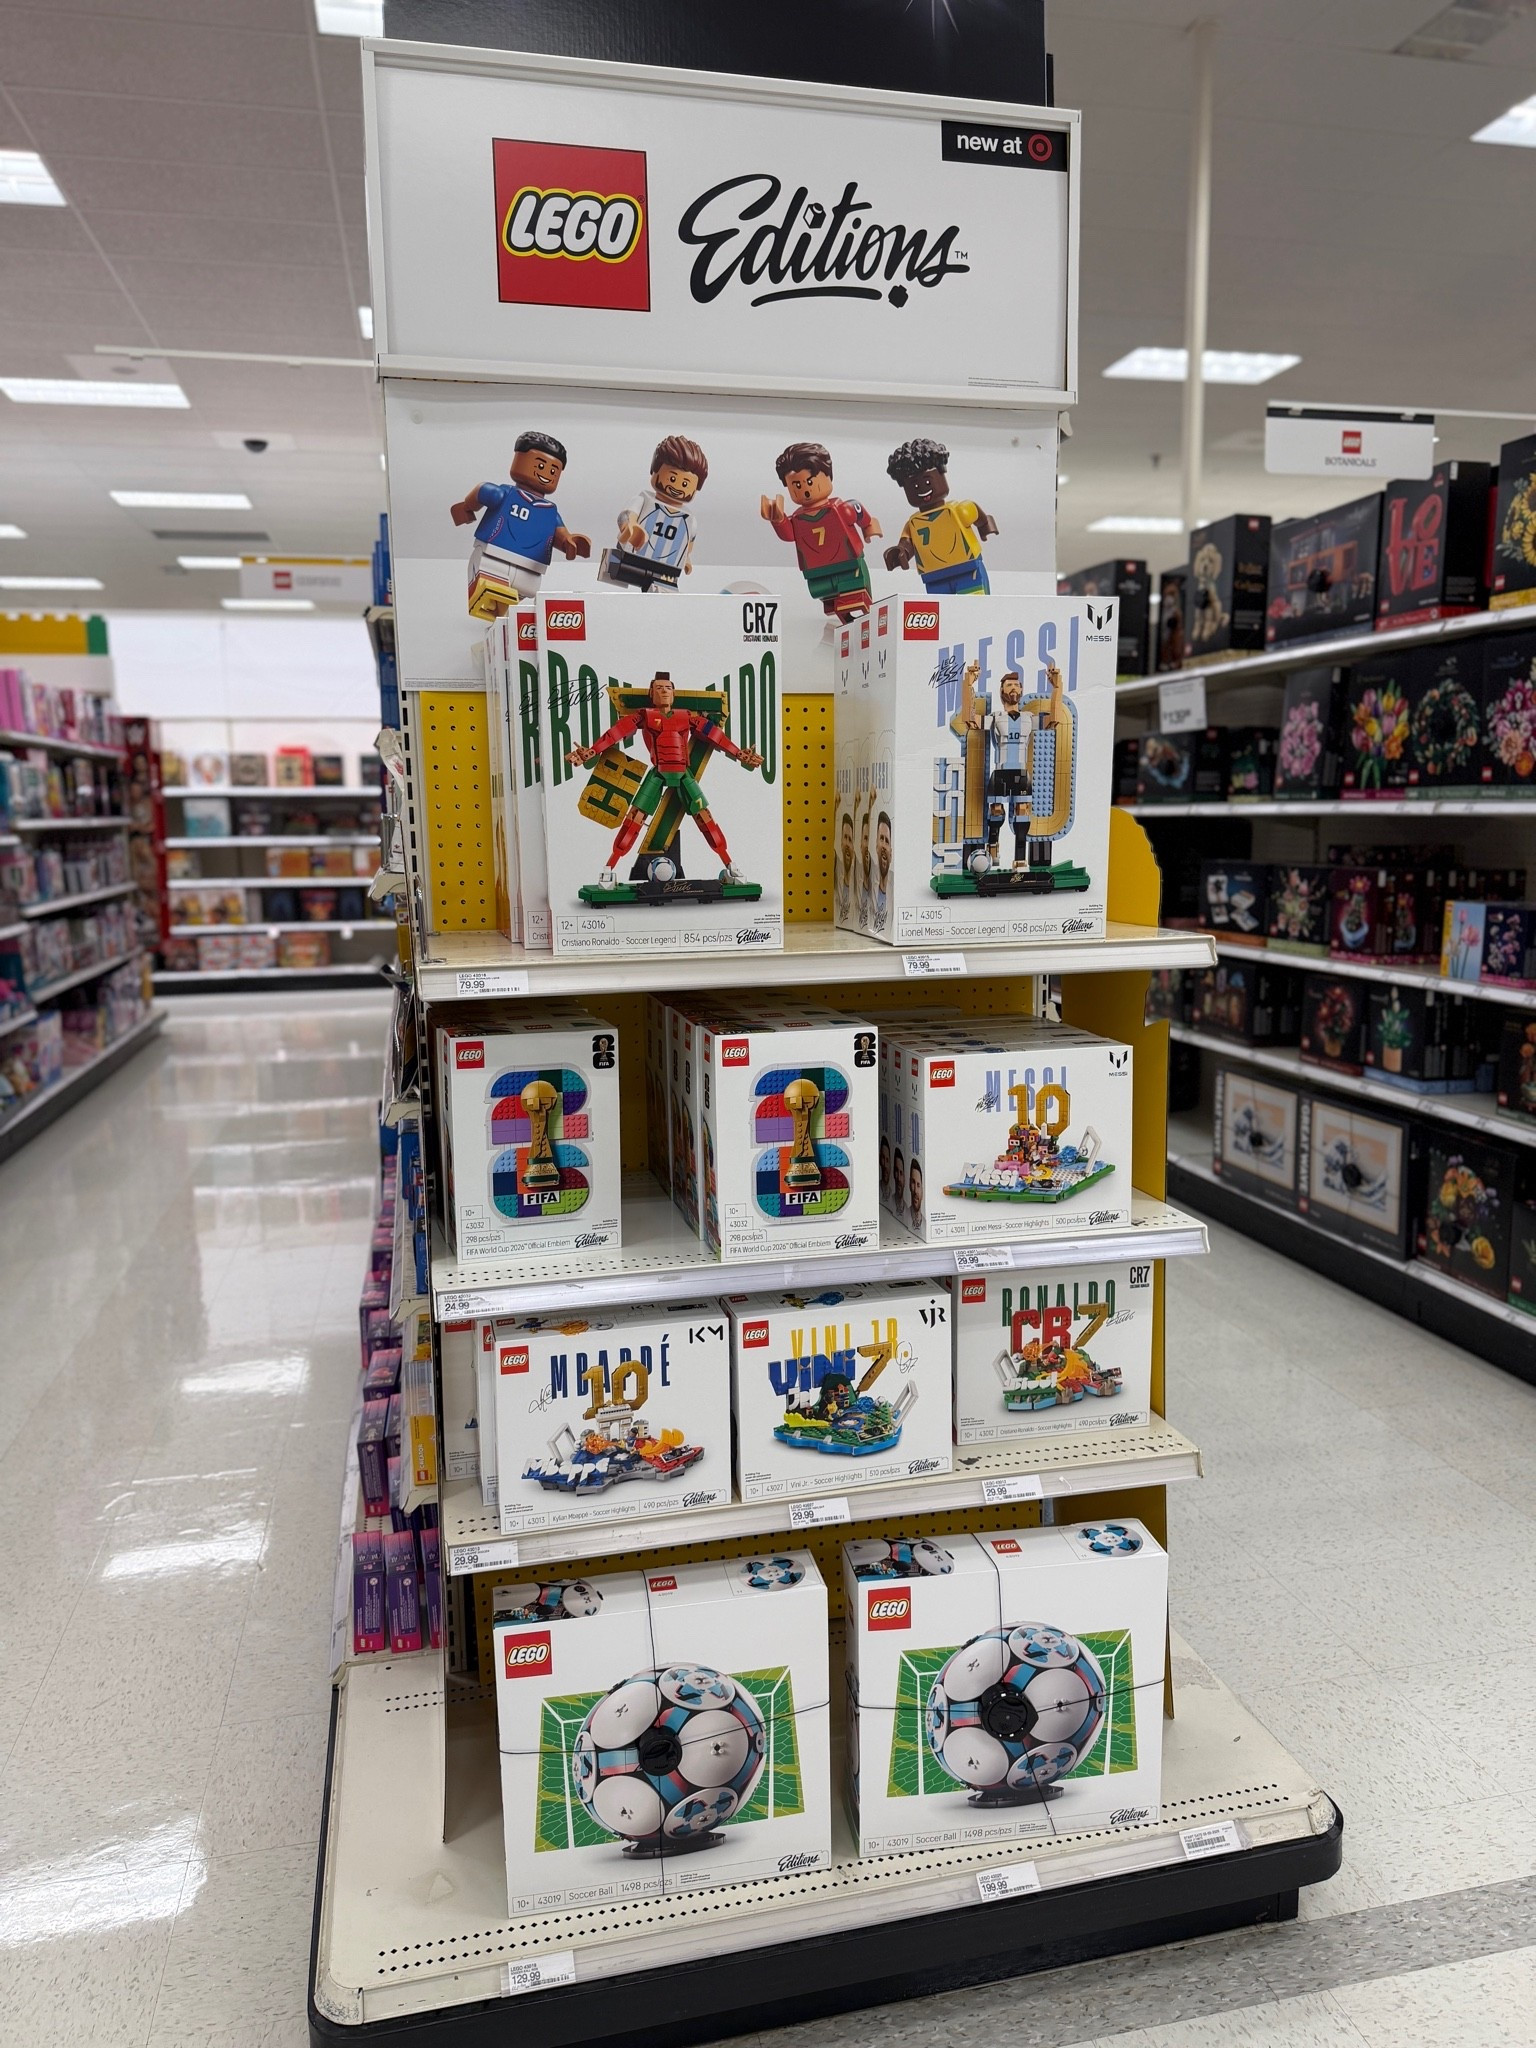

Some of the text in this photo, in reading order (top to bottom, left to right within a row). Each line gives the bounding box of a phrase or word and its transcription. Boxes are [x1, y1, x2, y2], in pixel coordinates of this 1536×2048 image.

[957, 133, 1023, 155] new at
[508, 191, 640, 258] LEGO
[678, 173, 970, 308] Editions
[510, 504, 528, 521] 10
[654, 522, 677, 540] 10
[812, 527, 825, 546] 7
[917, 528, 930, 545] 7
[548, 602, 778, 634] LEGO CR7
[906, 613, 936, 630] LEGO
[937, 616, 1080, 728] MESSI
[1008, 732, 1020, 740] 10
[901, 910, 942, 920] 12+ 43015
[560, 920, 606, 930] 12+ 43016
[901, 918, 1094, 937] Lionel Messi Soccer Legend 958 pcs/pzs Editions
[561, 928, 772, 948] Cristiano Ronaldo Soccer Legend 854 pcs/pzs Editions
[908, 961, 930, 969] 79.99
[460, 980, 486, 988] 79.99
[458, 1048, 484, 1061] LEGO
[723, 1048, 748, 1058] LEGO
[931, 1069, 954, 1080] LEGO
[527, 1192, 558, 1204] FIFA
[789, 1192, 819, 1204] FIFA
[465, 1209, 475, 1217] 10+
[466, 1222, 485, 1230] 43032
[730, 1220, 748, 1228] 43032
[950, 1226, 966, 1234] 43011
[972, 1224, 987, 1232] Lionel
[1005, 1221, 1023, 1229] Soccer
[1024, 1219, 1050, 1229] Highlights
[1056, 1217, 1066, 1225] 500
[1066, 1216, 1086, 1225] pcs/pzs
[1088, 1210, 1120, 1225] Editions
[466, 1233, 502, 1244] 298 pcs/pzs
[466, 1248, 479, 1256] FIFA
[479, 1246, 497, 1254] World
[528, 1241, 546, 1250] Official
[547, 1238, 571, 1248] Emblem
[574, 1232, 610, 1248] Editions
[730, 1232, 764, 1242] 298 pcs/pzs
[730, 1234, 869, 1254] FIFA World Cup Official Emblem Editions
[958, 1256, 979, 1265] 29.99
[963, 1266, 1150, 1296] LEGO CR7
[445, 1302, 470, 1312] 24.99
[744, 1328, 768, 1340] LEGO
[502, 1324, 724, 1366] LEGO KM
[550, 1334, 671, 1400] MBAPPÉ
[1000, 1427, 1017, 1436] Cristiano
[1018, 1426, 1034, 1434] Ronaldo
[1038, 1424, 1051, 1432] Soccer
[1052, 1422, 1072, 1431] Highlights
[1088, 1418, 1108, 1427] pcs/pzs
[1109, 1412, 1140, 1427] Editions
[766, 1484, 784, 1492] 43027
[790, 1480, 800, 1489] Vini
[801, 1480, 810, 1488] Jr.
[814, 1477, 833, 1486] Soccer
[834, 1472, 863, 1484] Highlights
[870, 1469, 880, 1477] 510
[880, 1466, 900, 1477] pcs/pzs
[908, 1458, 940, 1475] Editions
[986, 1487, 1007, 1496] 29.99
[510, 1520, 519, 1528] 10+
[528, 1517, 546, 1526] 43013
[552, 1514, 568, 1523] Kylian
[592, 1508, 610, 1518] Soccer
[610, 1504, 636, 1516] Highlights
[643, 1500, 656, 1510] 490
[656, 1498, 679, 1510] pcs/pzs
[682, 1491, 718, 1508] Editions
[792, 1510, 814, 1520] 29.99
[994, 1542, 1018, 1550] LEGO
[454, 1555, 478, 1566] 29.99
[650, 1579, 675, 1588] LEGO
[870, 1598, 909, 1618] LEGO
[508, 1644, 548, 1666] LEGO
[886, 1838, 910, 1848] 43019
[916, 1834, 942, 1844] Soccer
[943, 1832, 957, 1842] Ball
[964, 1828, 983, 1838] 1498
[984, 1826, 1012, 1838] pcs/pzs
[1110, 1808, 1150, 1824] Editions
[517, 1900, 530, 1909] 10+
[538, 1894, 562, 1905] 43019
[568, 1888, 596, 1901] Soccer
[598, 1886, 614, 1898] Ball
[621, 1882, 642, 1892] 1498
[643, 1877, 672, 1891] pcs/pzs
[778, 1850, 820, 1872] Editions
[982, 1880, 1008, 1893] 199.99
[512, 1971, 541, 1984] 129.99
